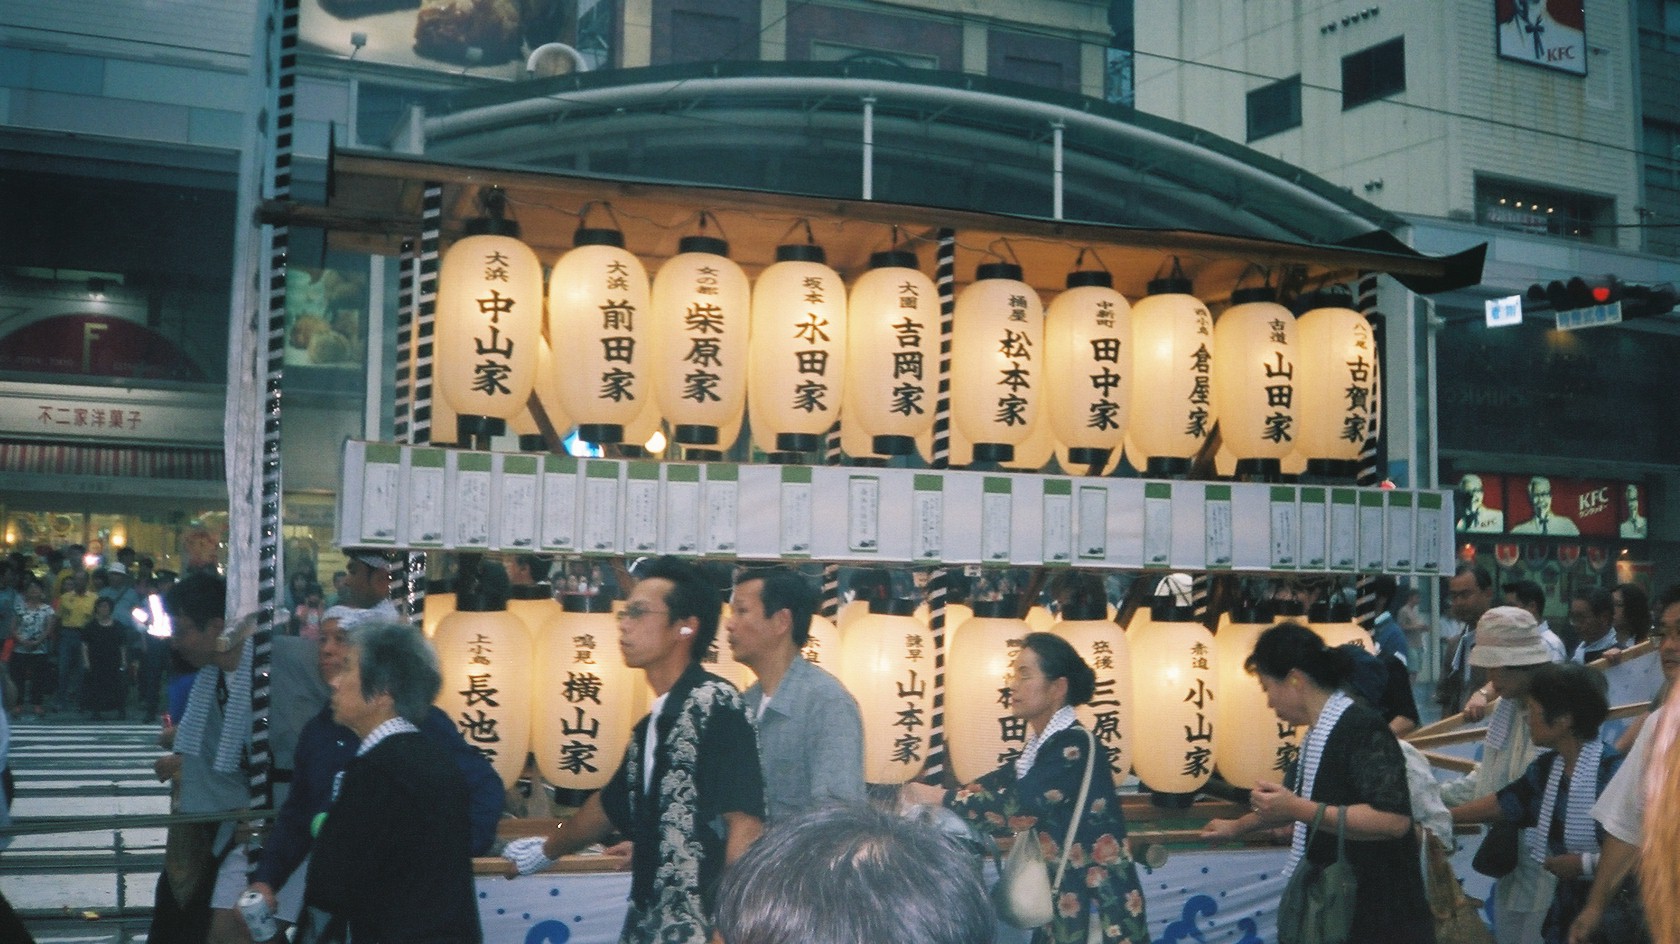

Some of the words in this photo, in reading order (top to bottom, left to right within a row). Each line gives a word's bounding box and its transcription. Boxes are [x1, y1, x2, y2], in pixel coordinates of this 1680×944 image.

[1547, 45, 1575, 62] KFC
[485, 250, 508, 283] 大浜
[606, 260, 628, 291] 大浜
[802, 276, 825, 304] 坂本
[82, 322, 108, 372] F
[471, 289, 516, 396] 中山家
[598, 299, 636, 403] 前田家
[681, 302, 724, 403] 柴原家
[791, 312, 831, 413] 水田家
[889, 317, 925, 416] 吉岡家
[994, 328, 1033, 426] 松本家
[1087, 337, 1121, 431] 田中家
[38, 405, 142, 430] 不二家洋菓子
[1185, 343, 1212, 438] 倉屋家
[1262, 351, 1294, 444] 山田家
[1340, 355, 1371, 443] 古賀家
[1579, 486, 1609, 511] KFC
[458, 673, 500, 763] 長池
[559, 671, 603, 775] 横山家
[890, 669, 926, 765] 山本家
[1181, 678, 1215, 778] 小山家
